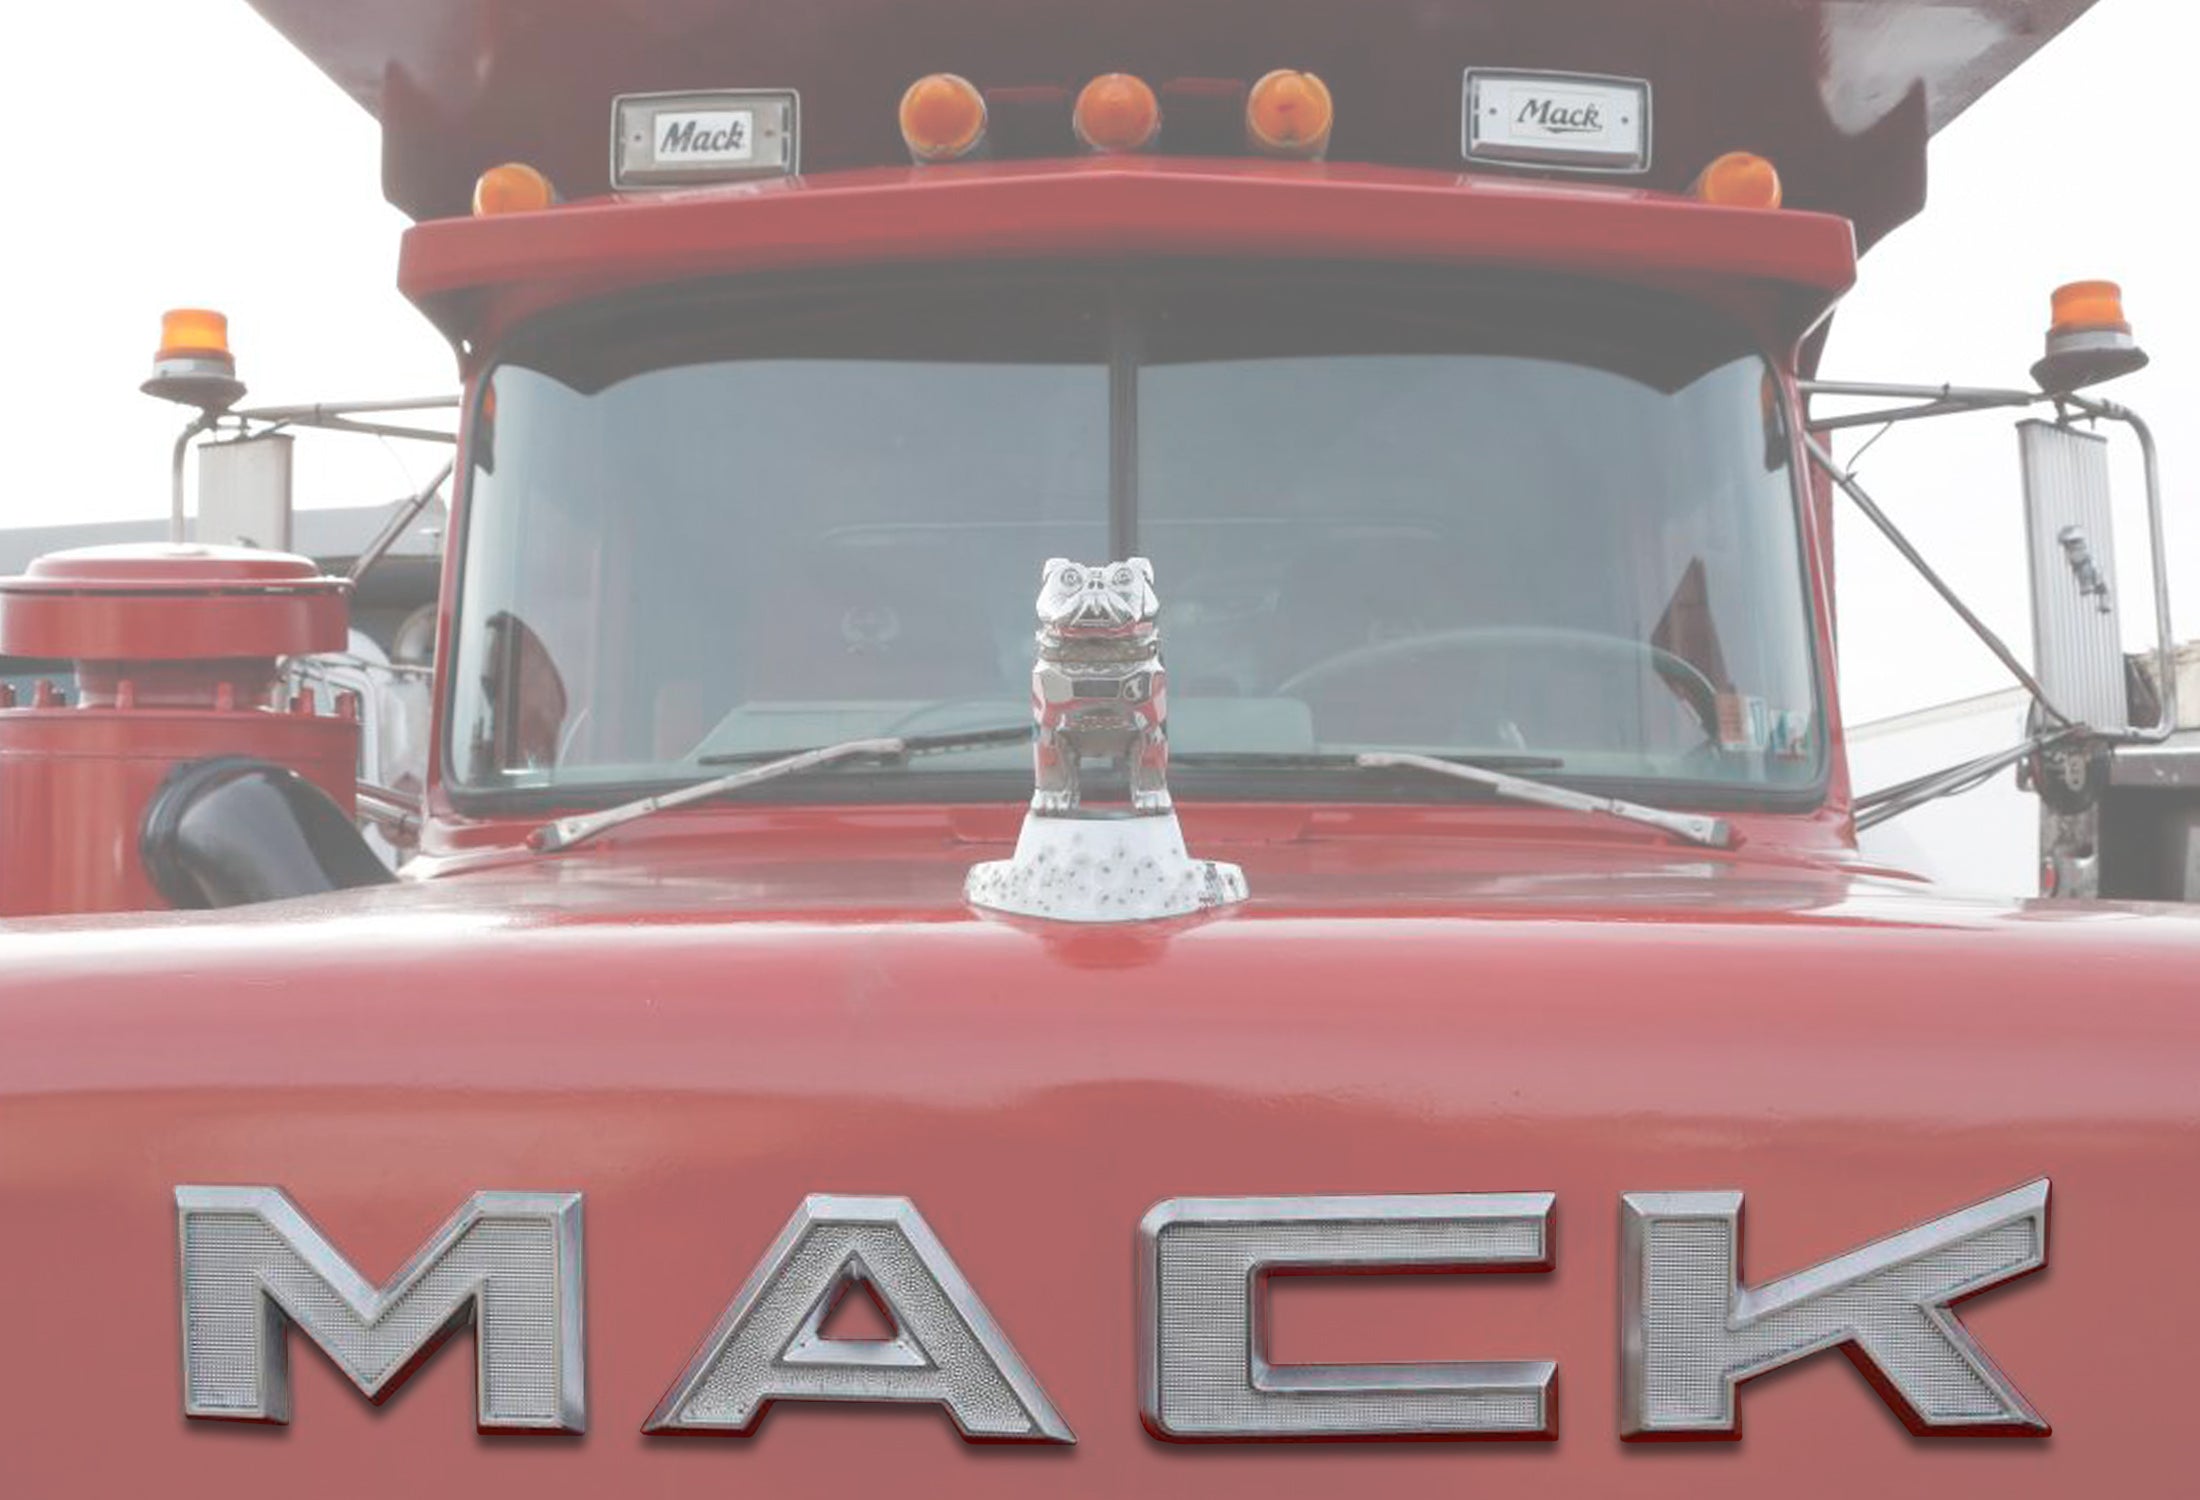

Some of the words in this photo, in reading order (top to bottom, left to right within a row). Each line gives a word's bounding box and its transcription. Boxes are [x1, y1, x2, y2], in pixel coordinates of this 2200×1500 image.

[1516, 98, 1603, 131] Mack
[660, 120, 745, 153] Mack
[173, 1177, 2053, 1445] MACK
